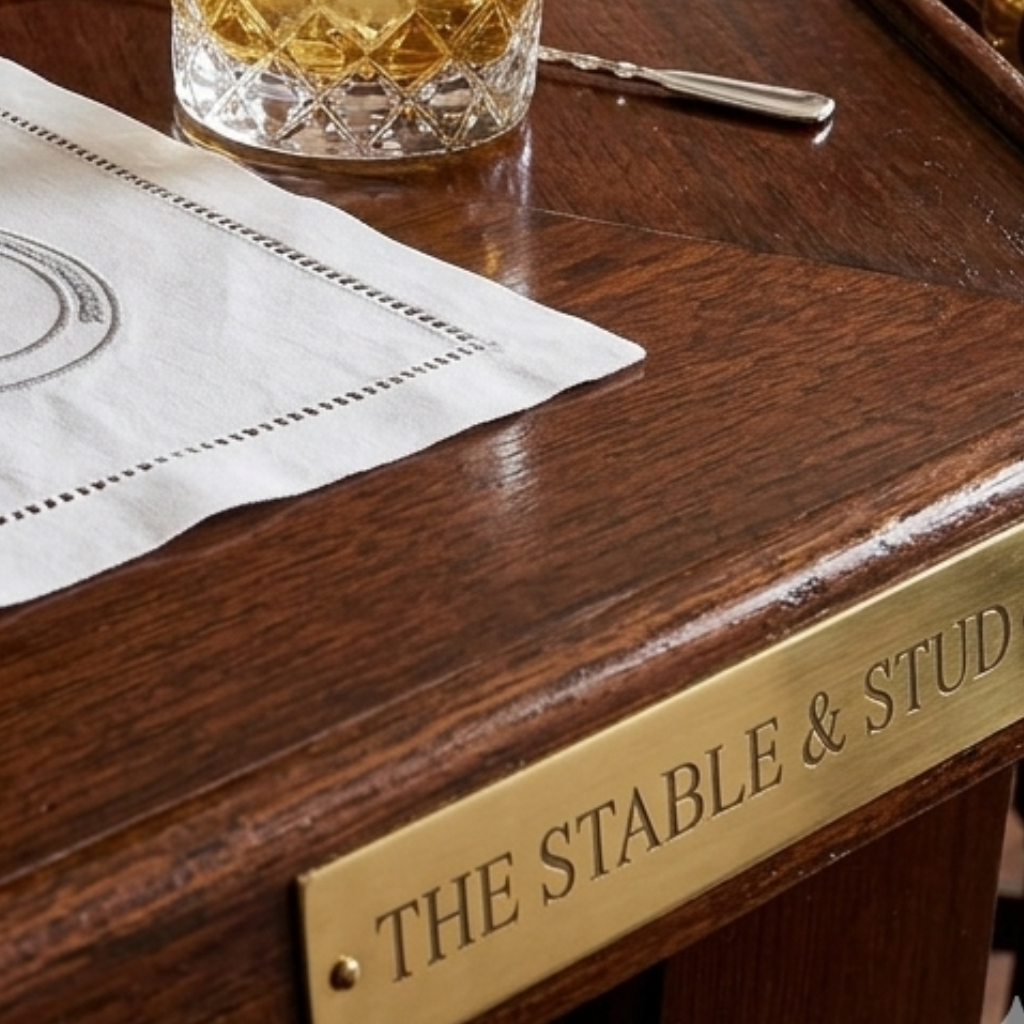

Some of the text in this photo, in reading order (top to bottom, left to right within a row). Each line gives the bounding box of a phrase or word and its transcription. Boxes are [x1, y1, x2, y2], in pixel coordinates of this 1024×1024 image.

[375, 604, 1011, 984] THE STABLE & STUD
